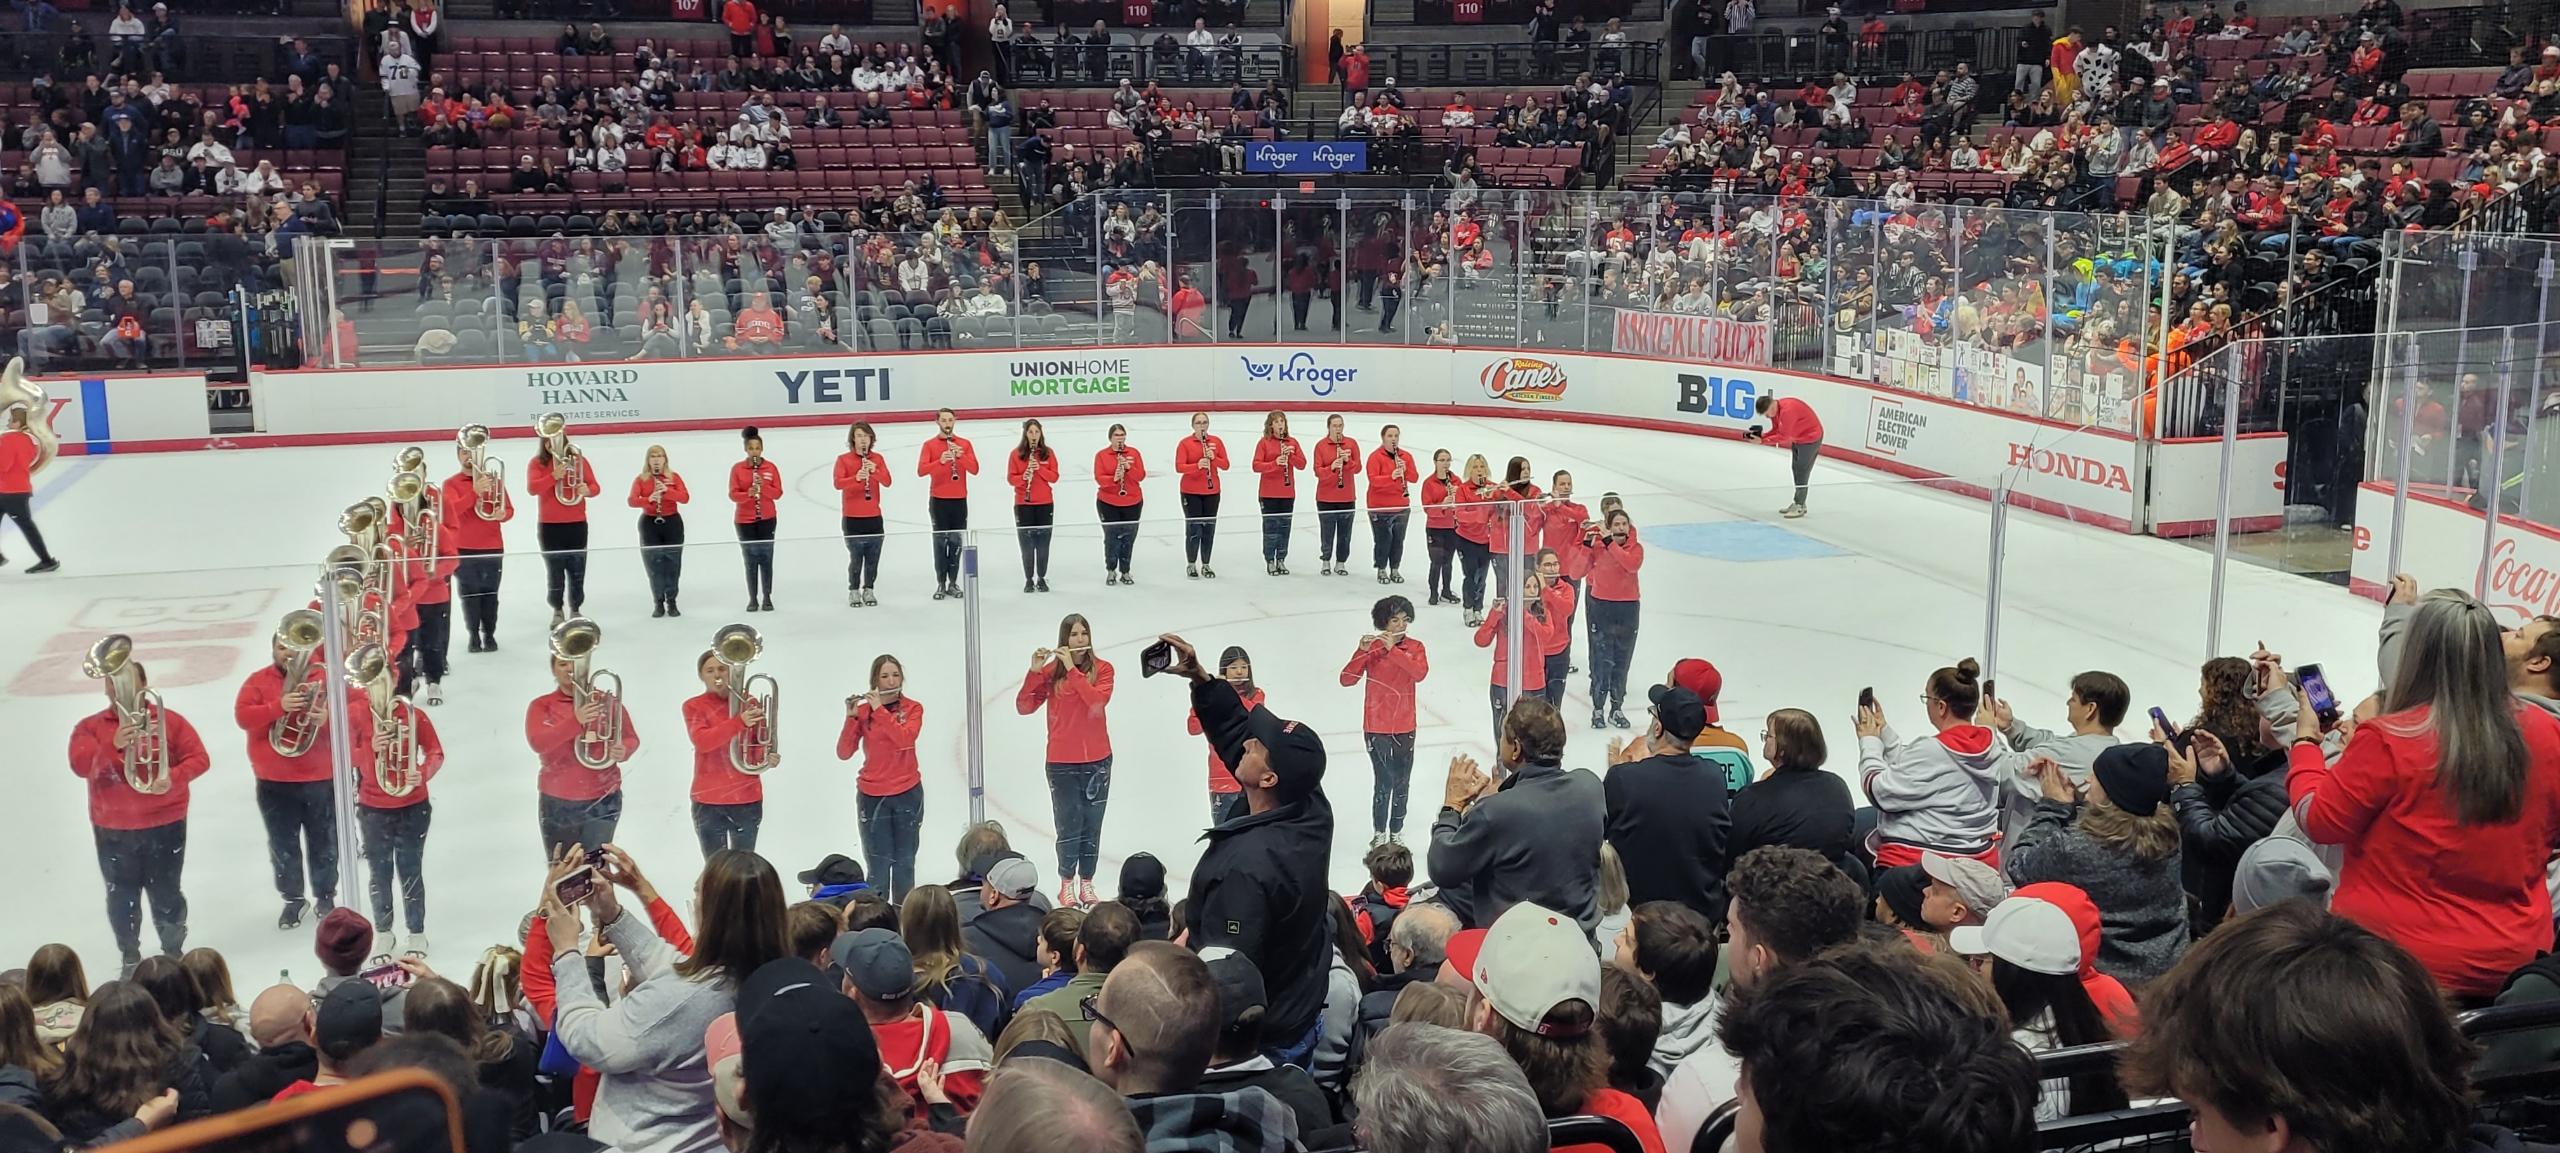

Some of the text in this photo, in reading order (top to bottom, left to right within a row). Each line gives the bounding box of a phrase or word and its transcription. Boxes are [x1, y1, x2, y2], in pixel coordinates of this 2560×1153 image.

[675, 0, 699, 10] 107
[1127, 5, 1148, 16] 110
[1458, 2, 1478, 14] 110
[1255, 144, 1356, 169] Kroger Kroger
[1514, 359, 1544, 369] Raising
[527, 369, 639, 387] HOWARD
[1279, 352, 1358, 396] Kroger
[1484, 357, 1567, 399] Cane's
[775, 368, 890, 404] YETI
[1010, 376, 1130, 396] MORTGAGE
[542, 388, 629, 405] HANNA
[564, 411, 592, 420] STATE
[593, 409, 641, 418] SERVICES
[1879, 406, 1927, 428] AMERICAN
[1877, 419, 1916, 439] ELECTRIC
[1875, 431, 1908, 450] POWER
[2007, 442, 2132, 493] HONDA
